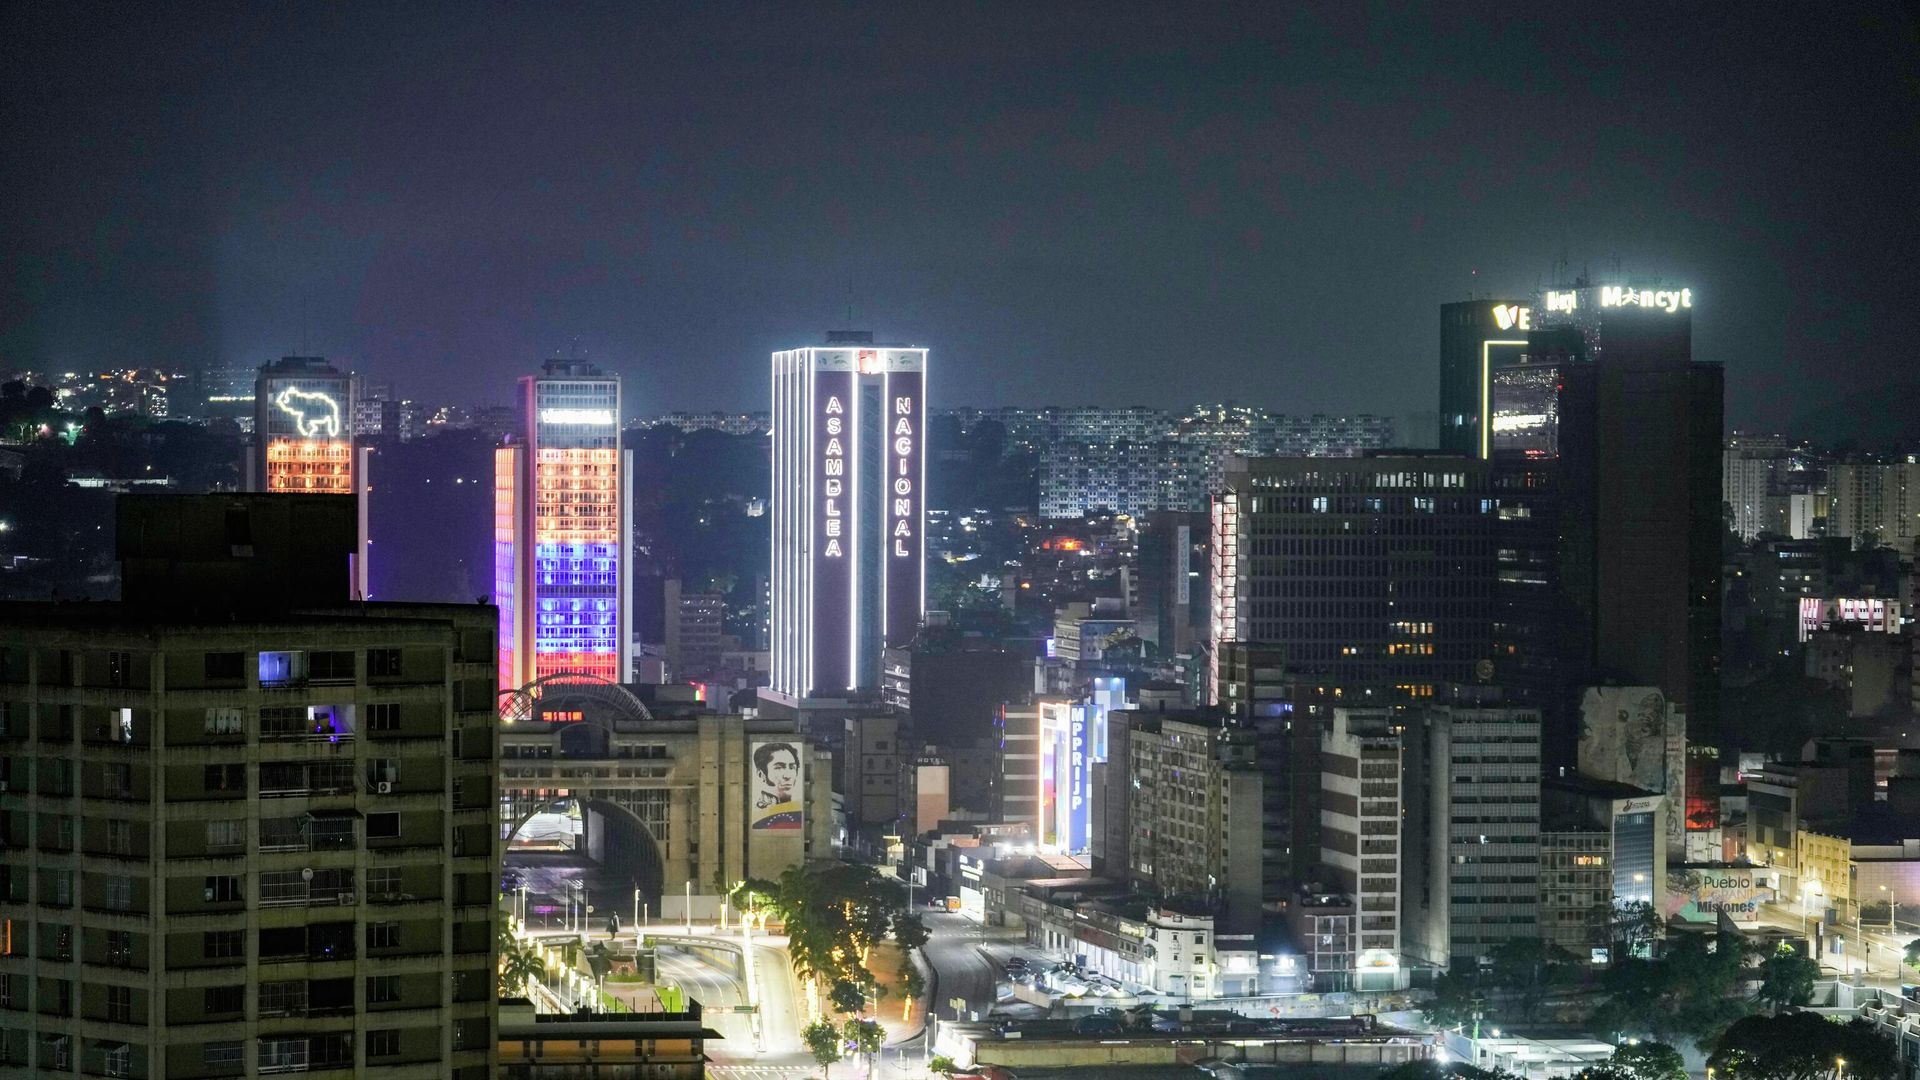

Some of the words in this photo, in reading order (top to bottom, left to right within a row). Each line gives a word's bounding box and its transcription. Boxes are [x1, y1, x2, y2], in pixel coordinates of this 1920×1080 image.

[825, 396, 843, 557] ASAMBLEA
[895, 397, 912, 557] NACIONAL
[1071, 707, 1085, 811] MPPRIJP
[1697, 901, 1755, 913] Misiones
[1704, 875, 1750, 888] Pueblo
